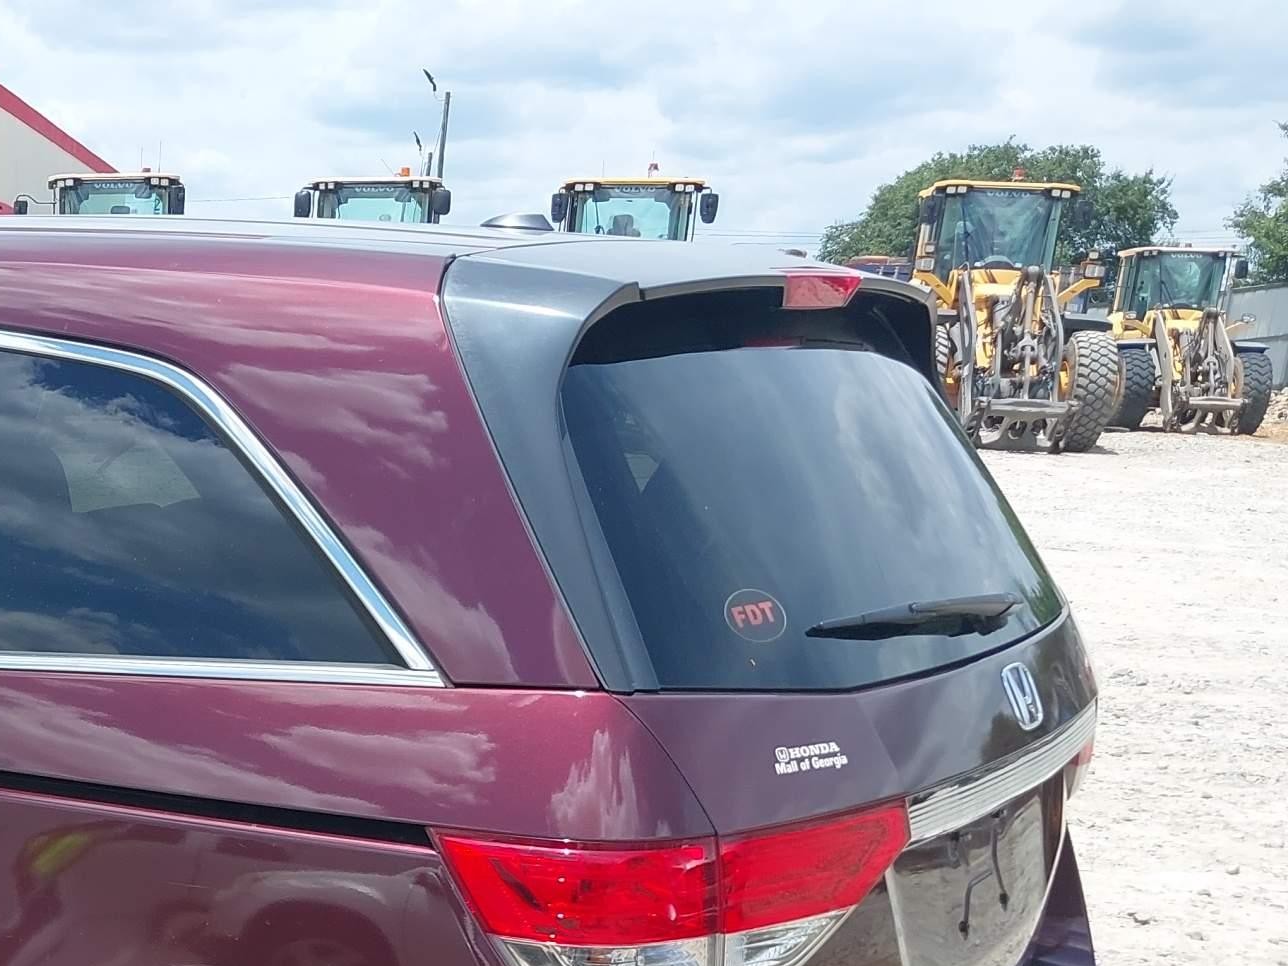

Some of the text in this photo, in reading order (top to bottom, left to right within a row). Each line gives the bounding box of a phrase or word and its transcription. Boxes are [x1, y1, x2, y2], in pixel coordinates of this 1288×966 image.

[615, 185, 656, 193] VOLVO
[730, 600, 775, 629] FDT
[788, 741, 841, 759] HONDA
[774, 753, 849, 776] Mall of Georgia
